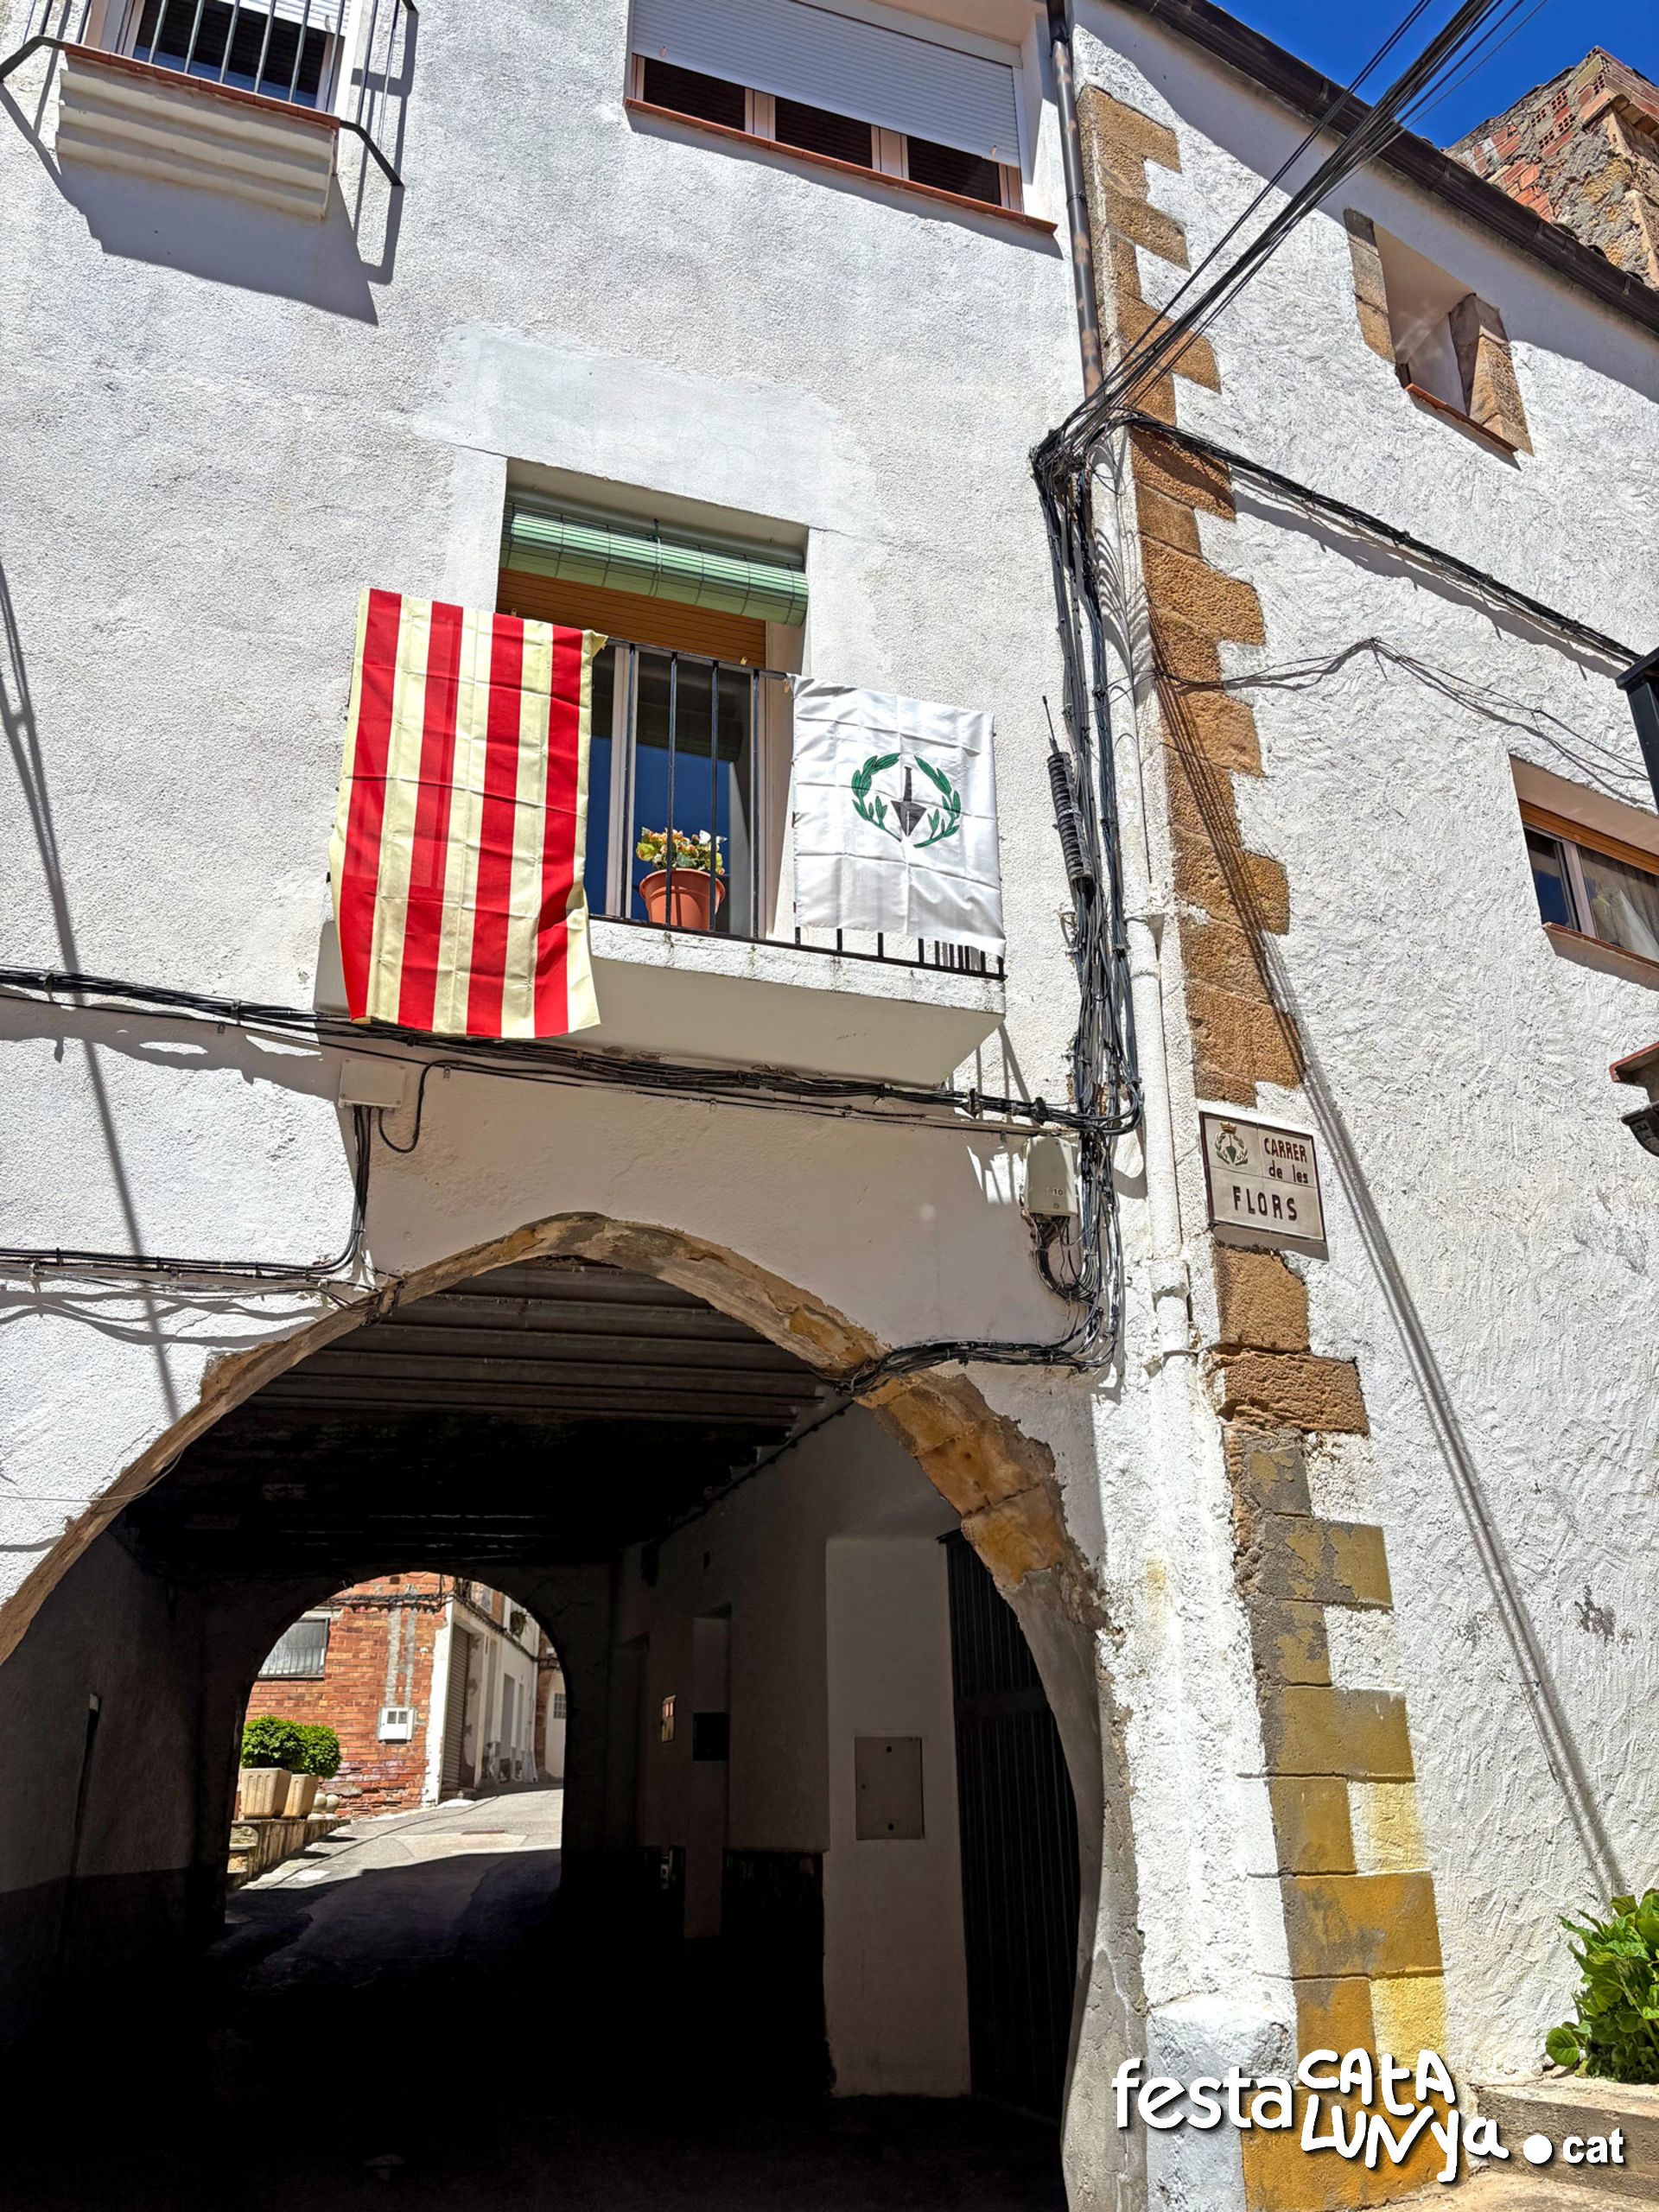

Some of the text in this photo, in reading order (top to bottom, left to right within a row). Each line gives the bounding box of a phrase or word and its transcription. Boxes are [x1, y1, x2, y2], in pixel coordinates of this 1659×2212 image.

[1263, 1137, 1307, 1163] CARRER
[1268, 1160, 1308, 1184] de les
[1232, 1185, 1298, 1221] FLORS
